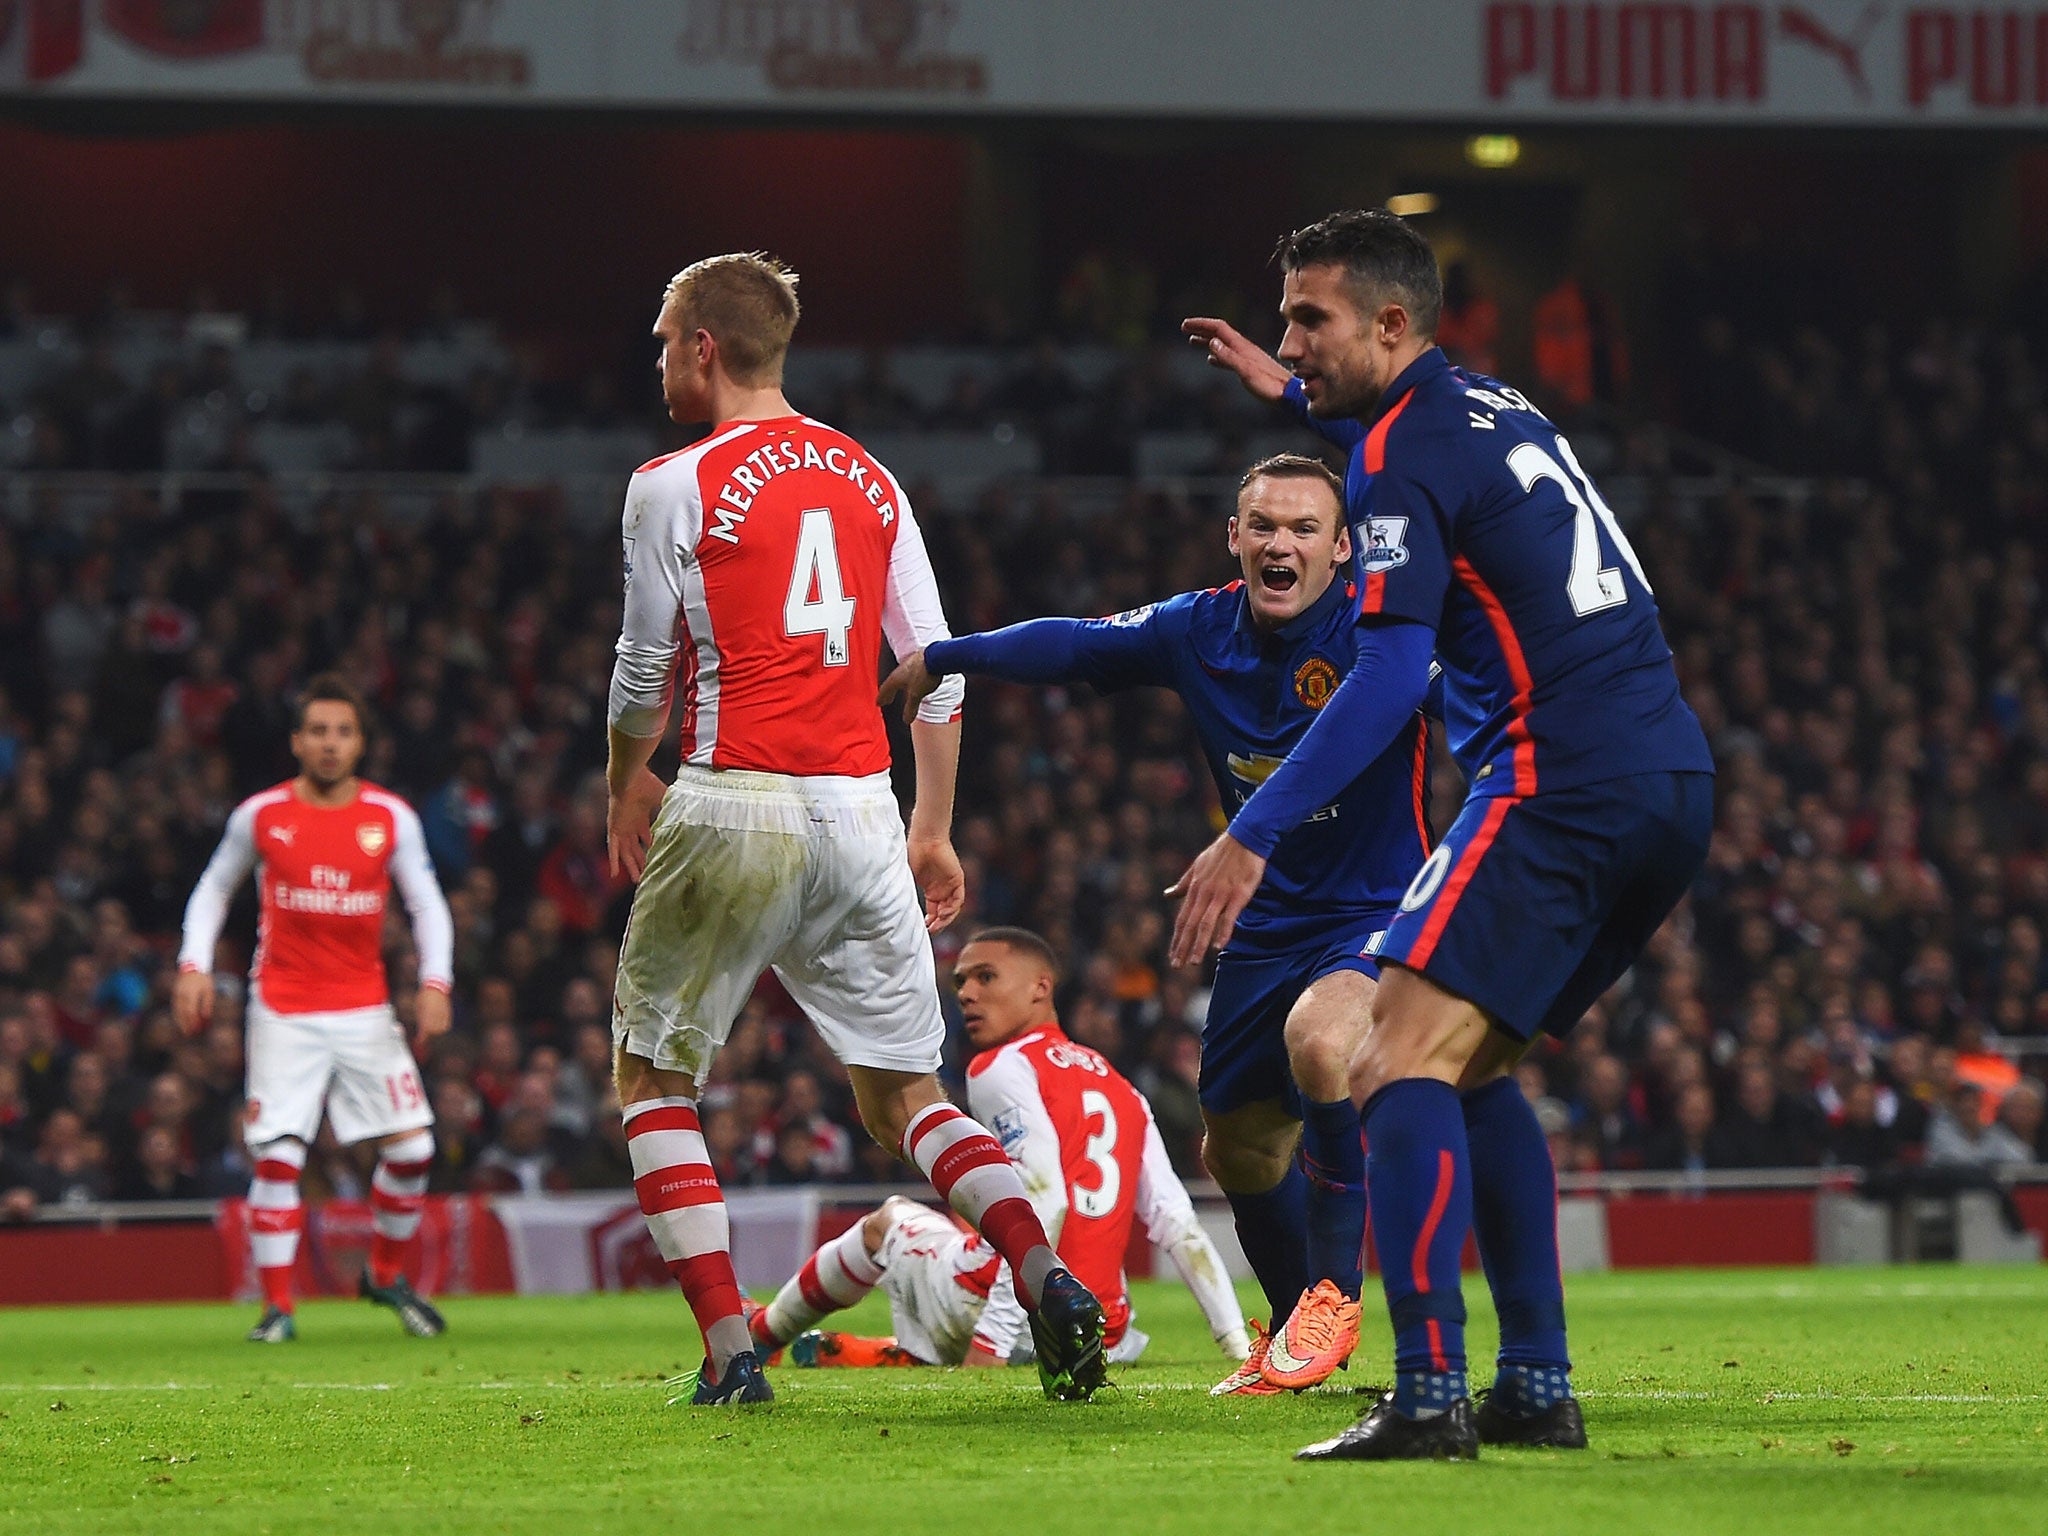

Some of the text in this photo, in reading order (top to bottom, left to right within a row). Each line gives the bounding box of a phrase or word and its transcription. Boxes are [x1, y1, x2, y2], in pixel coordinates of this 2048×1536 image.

[1484, 3, 1768, 101] PUMA
[1906, 10, 2048, 106] PU
[708, 440, 896, 545] MERTESACKER
[783, 507, 857, 667] 4
[385, 1072, 423, 1112] 19
[1073, 1089, 1121, 1218] 3
